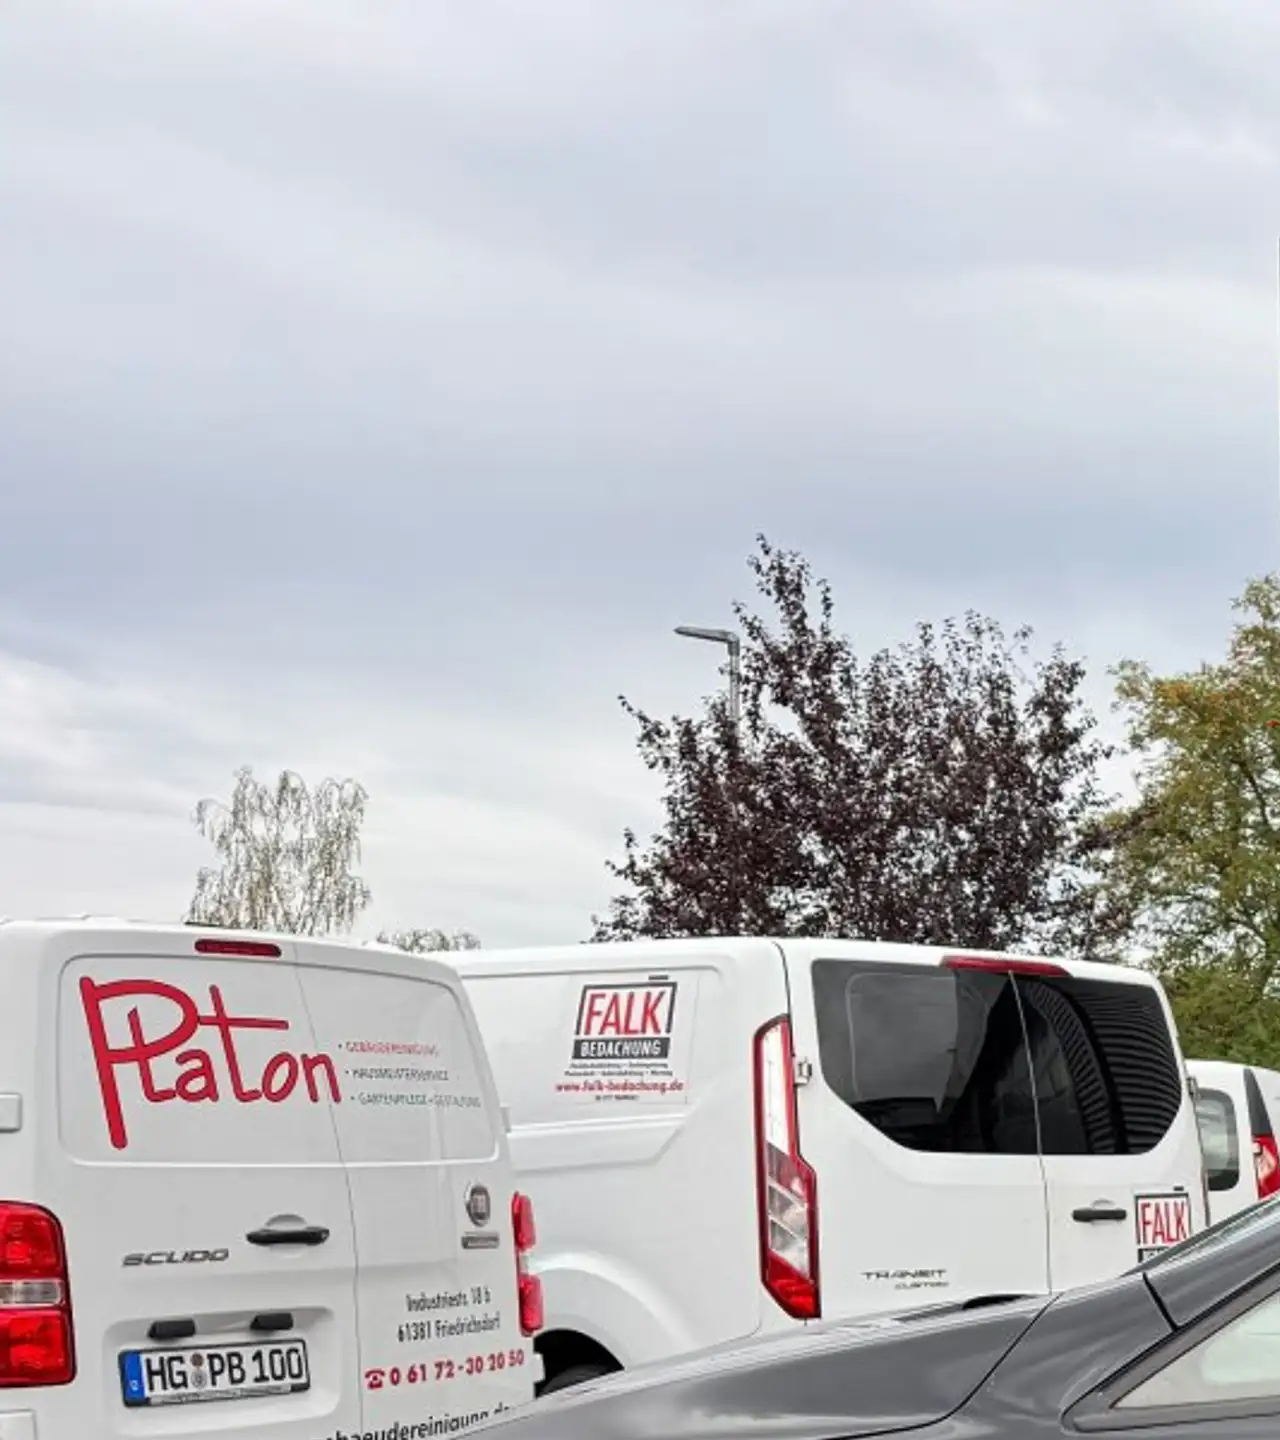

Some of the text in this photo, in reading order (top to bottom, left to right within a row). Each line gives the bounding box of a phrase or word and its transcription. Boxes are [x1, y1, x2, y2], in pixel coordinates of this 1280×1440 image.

[583, 990, 665, 1036] FALK
[80, 976, 341, 1149] Platon
[580, 1039, 662, 1058] BEDACHUNG
[1140, 1201, 1188, 1245] FALK
[121, 1248, 230, 1268] SCUDO
[398, 1320, 431, 1342] 61381
[145, 1347, 304, 1391] HG PB 100
[389, 1367, 402, 1386] 0
[407, 1363, 427, 1384] 61
